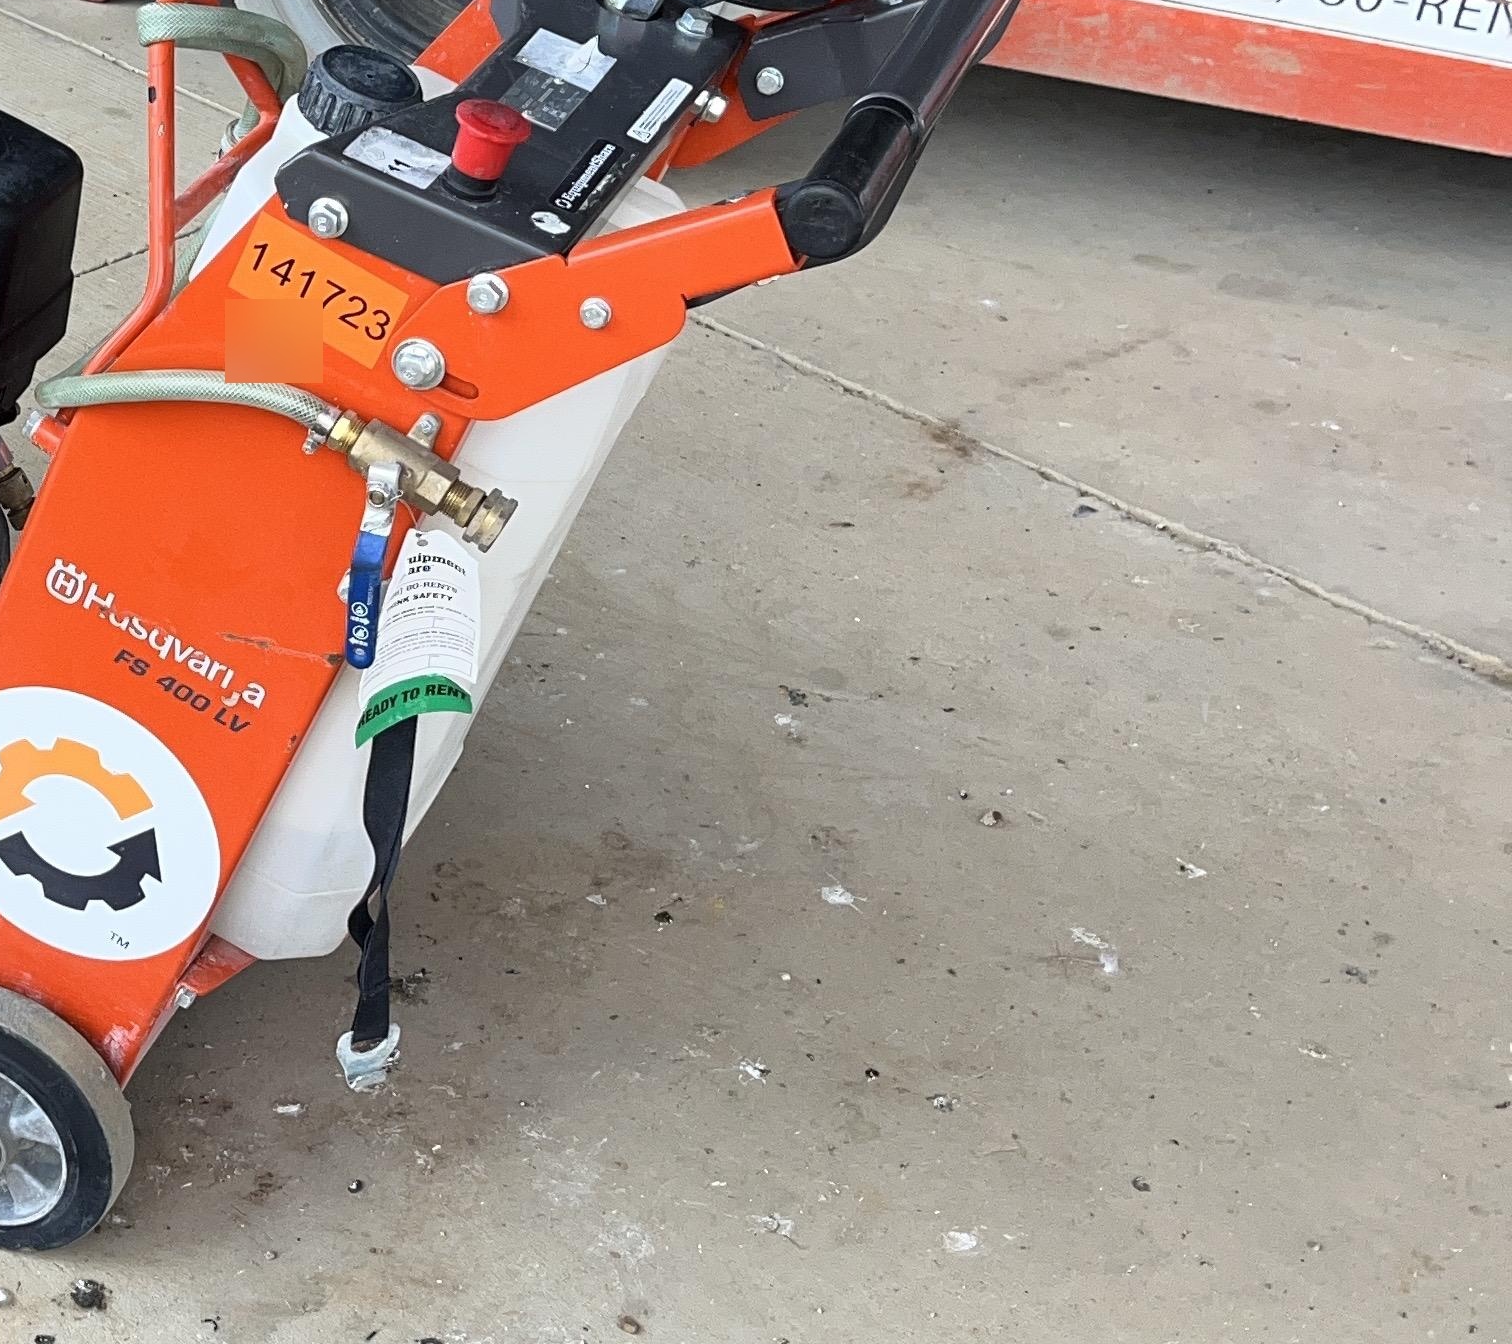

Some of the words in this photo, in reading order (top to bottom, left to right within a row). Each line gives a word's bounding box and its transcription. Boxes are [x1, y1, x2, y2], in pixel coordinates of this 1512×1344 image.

[565, 143, 617, 203] EquipmentShare
[252, 243, 391, 341] 141723
[412, 592, 453, 602] SAFETY
[113, 648, 151, 677] FS
[156, 675, 212, 713] 400
[213, 707, 252, 733] LV
[357, 693, 398, 730] READY
[401, 687, 420, 703] TO
[424, 683, 468, 700] RENT
